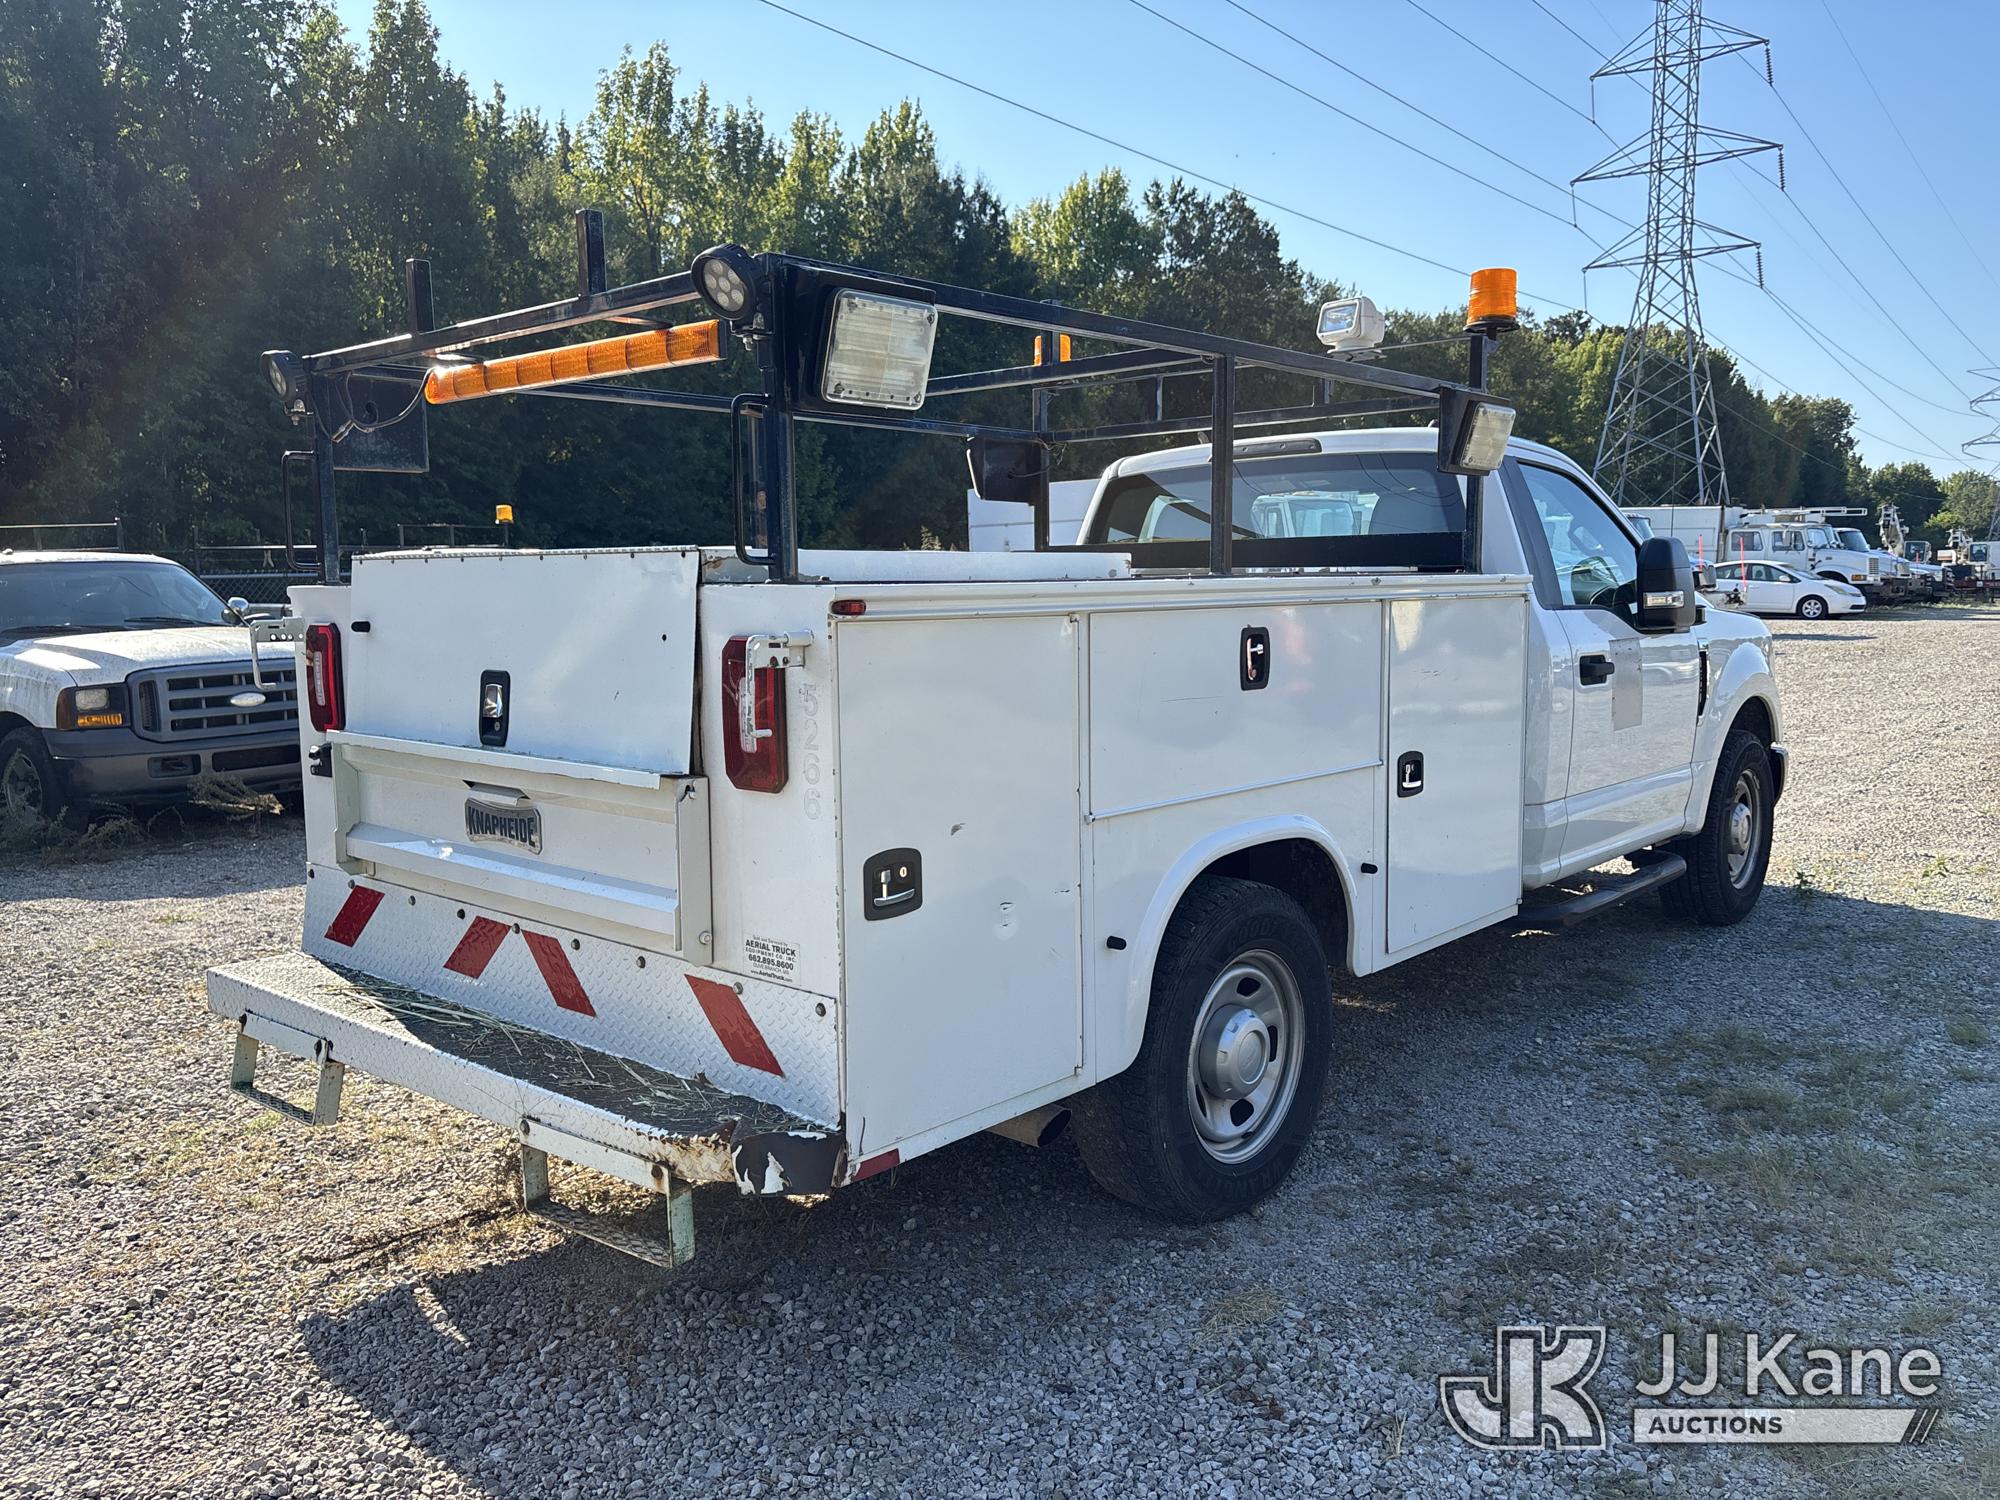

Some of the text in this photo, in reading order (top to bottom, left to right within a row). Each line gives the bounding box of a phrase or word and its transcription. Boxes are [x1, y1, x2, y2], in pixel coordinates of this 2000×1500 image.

[467, 806, 536, 848] KNAPHEIDE
[745, 939, 797, 957] AERIAL TRUCK
[745, 947, 774, 958] EQUIPMENT
[748, 953, 794, 971] 662.895.8600
